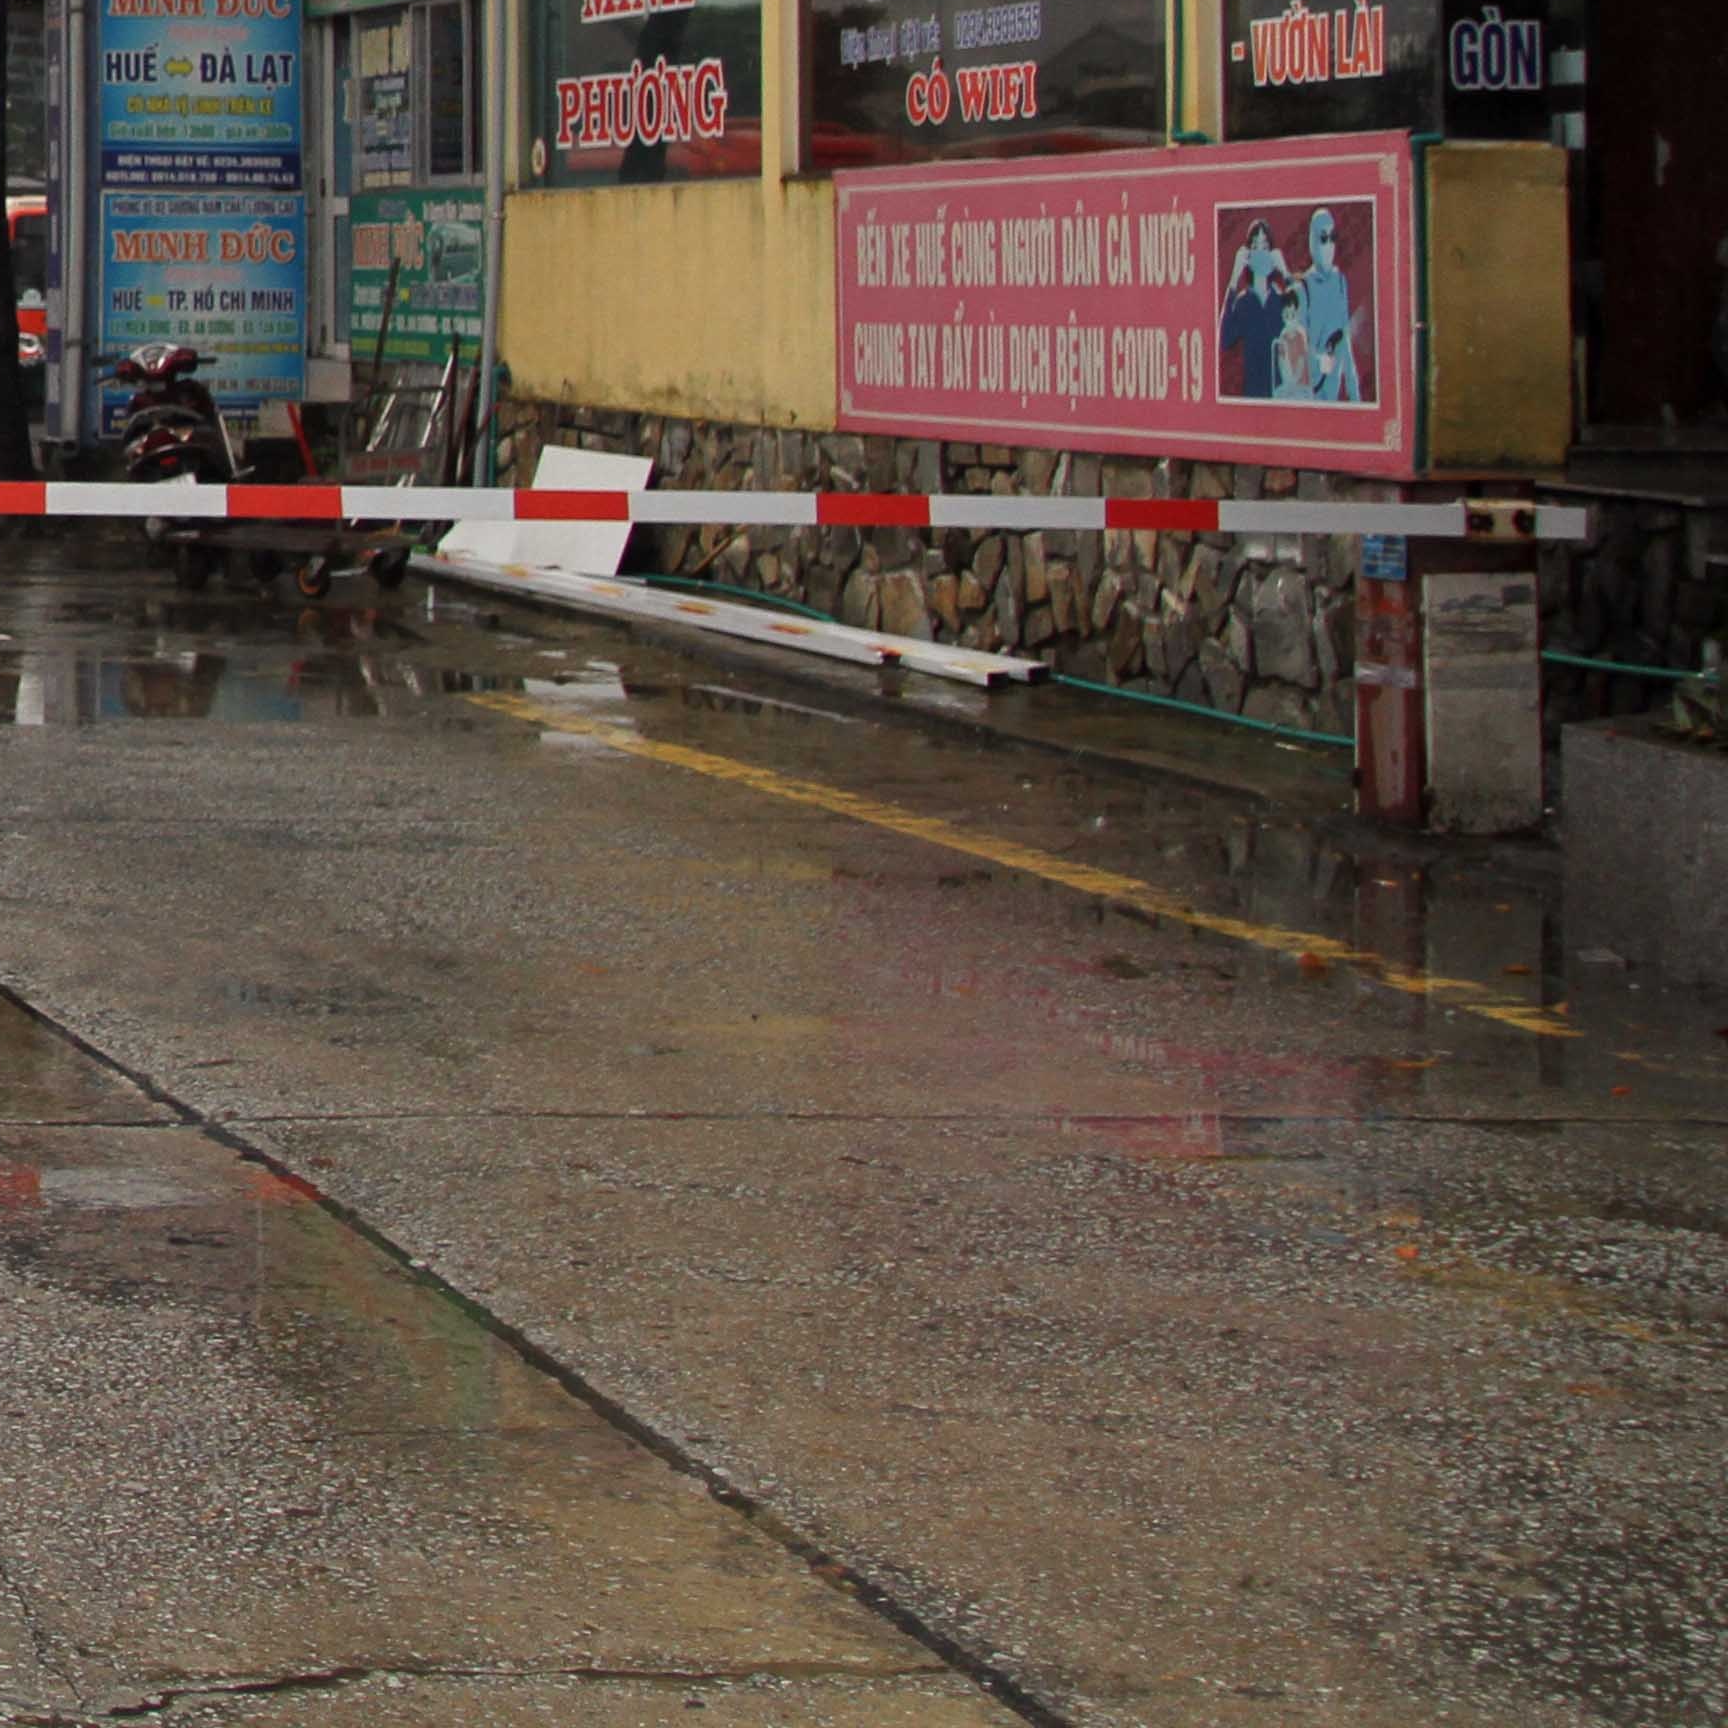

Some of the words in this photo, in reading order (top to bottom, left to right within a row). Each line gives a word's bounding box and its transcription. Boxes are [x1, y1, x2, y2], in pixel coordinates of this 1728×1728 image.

[106, 42, 159, 82] HUẾ
[199, 47, 237, 84] ĐÀ
[246, 52, 294, 91] LẠT
[1450, 5, 1543, 92] GÒN
[556, 55, 727, 151] PHƯƠNG
[906, 55, 950, 126] CÓ
[956, 59, 1038, 124] WIFI
[111, 229, 209, 264] MINH
[220, 221, 297, 264] ĐỨC
[856, 204, 887, 287] BẾN
[891, 223, 912, 287] XE
[915, 203, 948, 288] HUẾ
[951, 204, 996, 288] CÙNG
[1001, 201, 1056, 288] NGƯỜI
[1060, 198, 1101, 288] DÂN
[1106, 191, 1134, 287] CẢ
[1139, 194, 1196, 287] NƯỚC
[112, 286, 144, 312] HUẾ
[167, 289, 189, 312] TP.
[193, 282, 215, 312] HỒ
[220, 286, 246, 313] CHÍ
[251, 289, 295, 313] MINH
[853, 320, 905, 386] CHUNG
[908, 323, 937, 388] TAY
[941, 301, 976, 390] ĐẨY
[978, 309, 1005, 392] LÙI
[1009, 324, 1052, 409] DỊCH
[1055, 310, 1106, 412] BỆNH
[1110, 325, 1204, 403] COVID-19
